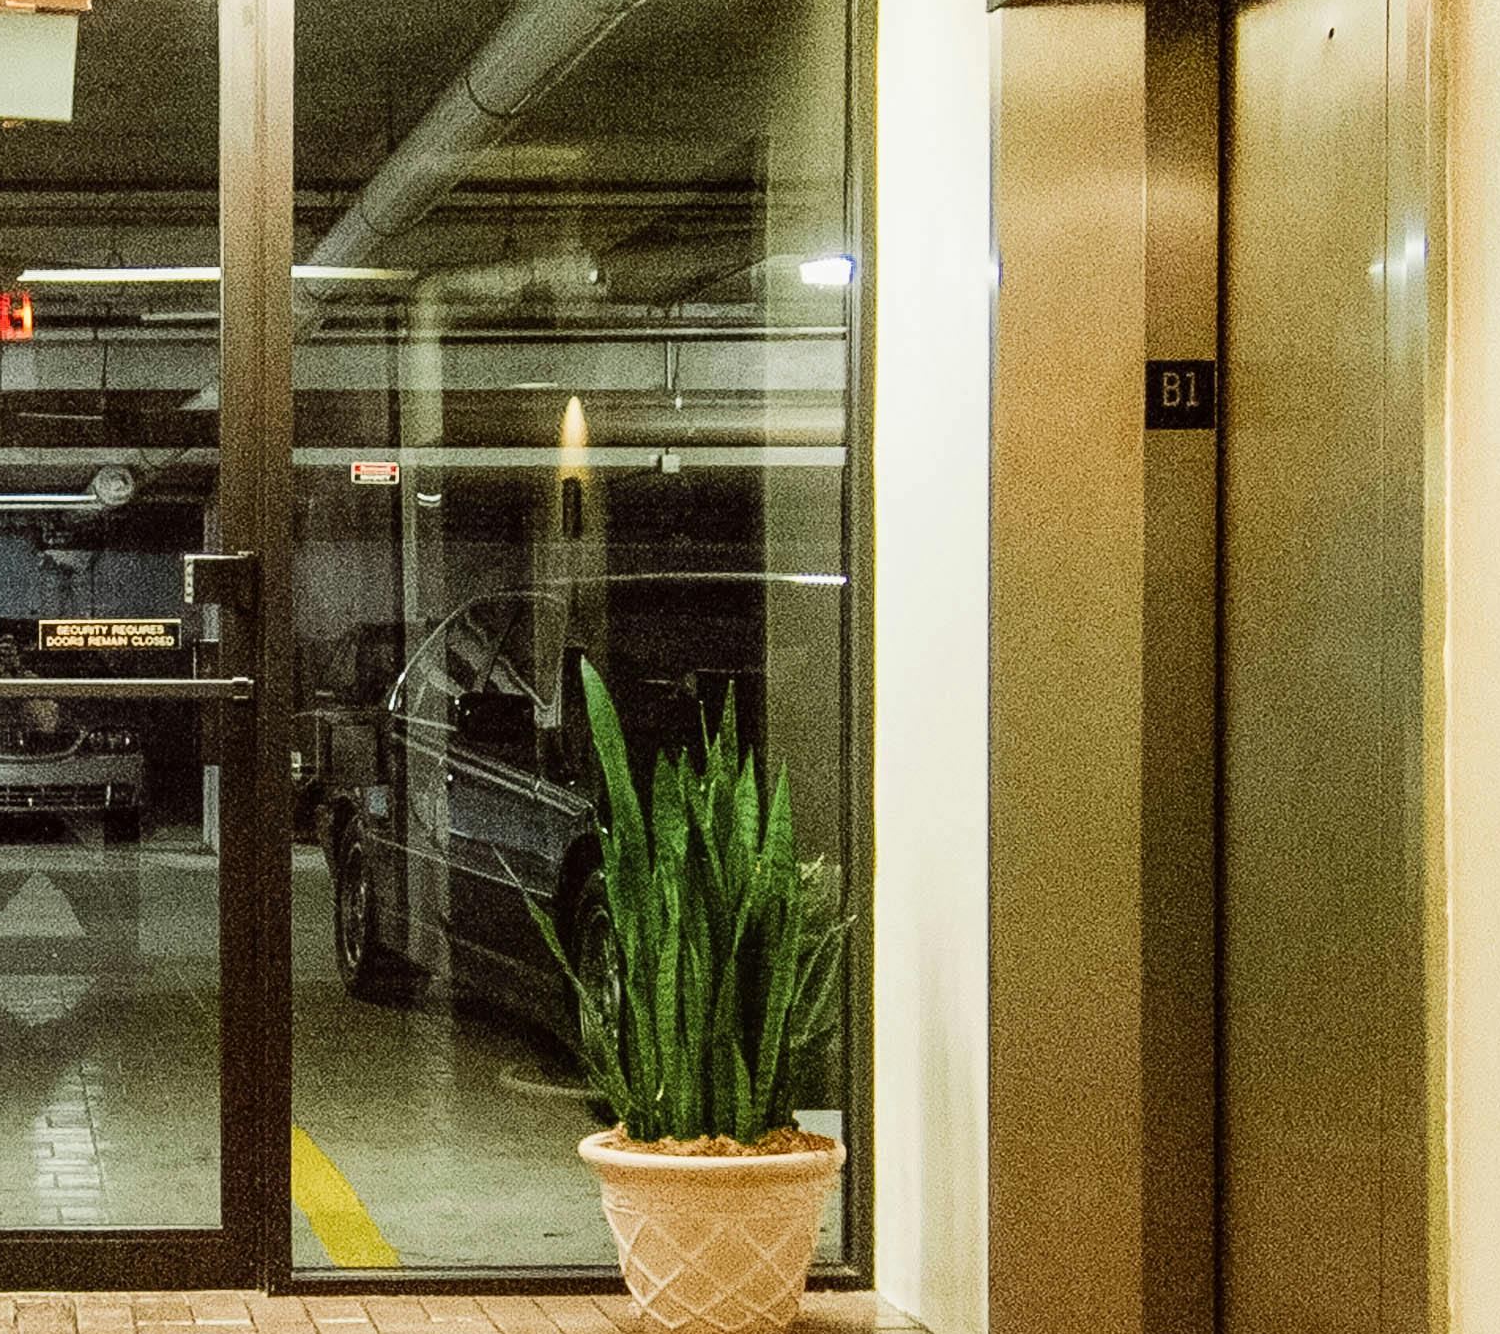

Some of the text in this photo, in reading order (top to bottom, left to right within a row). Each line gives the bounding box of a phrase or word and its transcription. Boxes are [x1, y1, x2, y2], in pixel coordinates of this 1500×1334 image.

[1162, 371, 1200, 407] B1
[56, 624, 165, 636] SECURITY REQUIRES
[46, 635, 175, 647] DOORS REMAIN CLOSED
